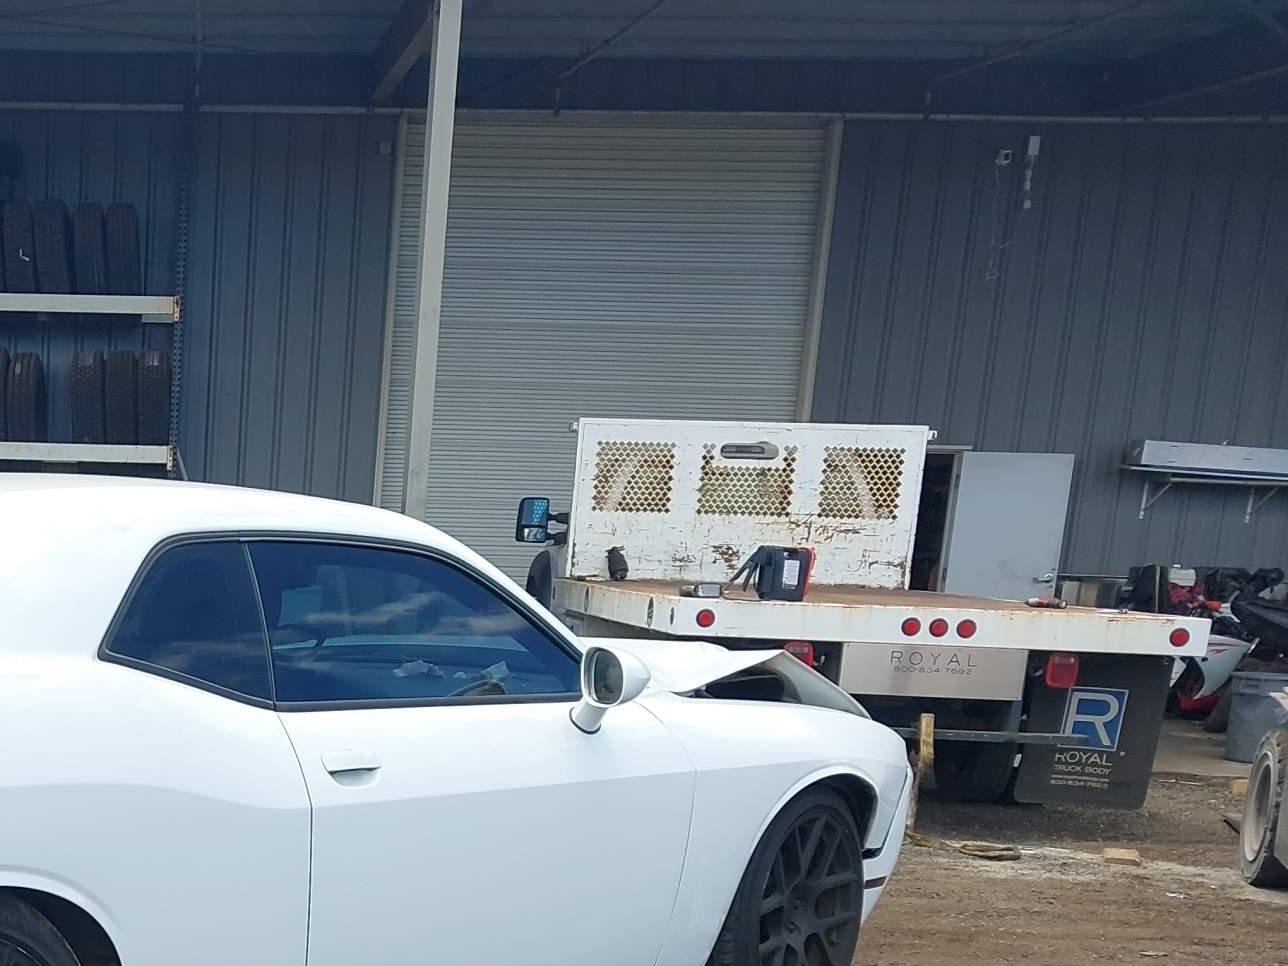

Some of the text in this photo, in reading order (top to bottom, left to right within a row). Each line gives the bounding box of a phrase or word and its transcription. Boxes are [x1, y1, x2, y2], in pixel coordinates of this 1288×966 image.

[890, 650, 978, 667] ROYAL
[1063, 691, 1120, 746] R
[1054, 751, 1113, 766] ROYAL
[1054, 764, 1112, 775] TRUCK BODY
